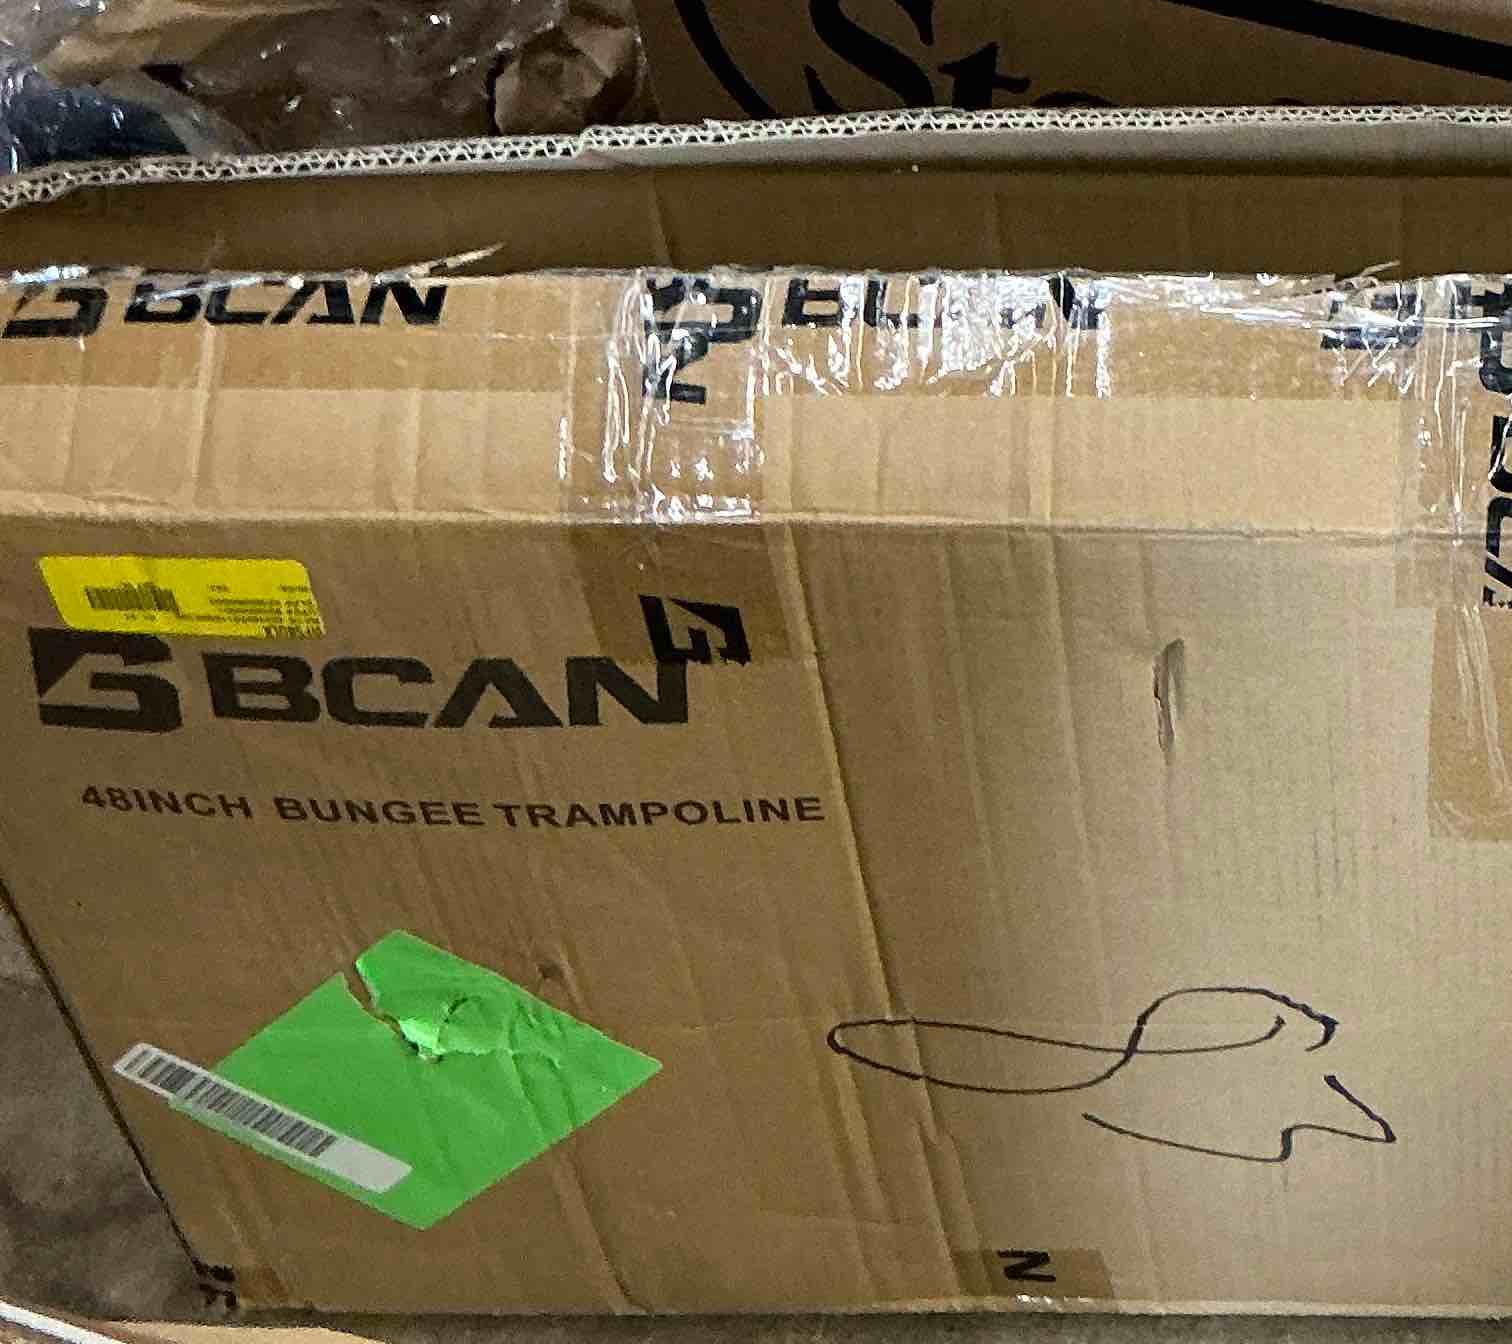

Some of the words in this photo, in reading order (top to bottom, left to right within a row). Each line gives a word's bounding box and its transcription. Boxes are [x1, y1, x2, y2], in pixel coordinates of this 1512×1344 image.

[81, 784, 252, 821] 48INCH
[274, 796, 486, 827] BUNGEE
[494, 795, 825, 829] TRAMPOLINE
